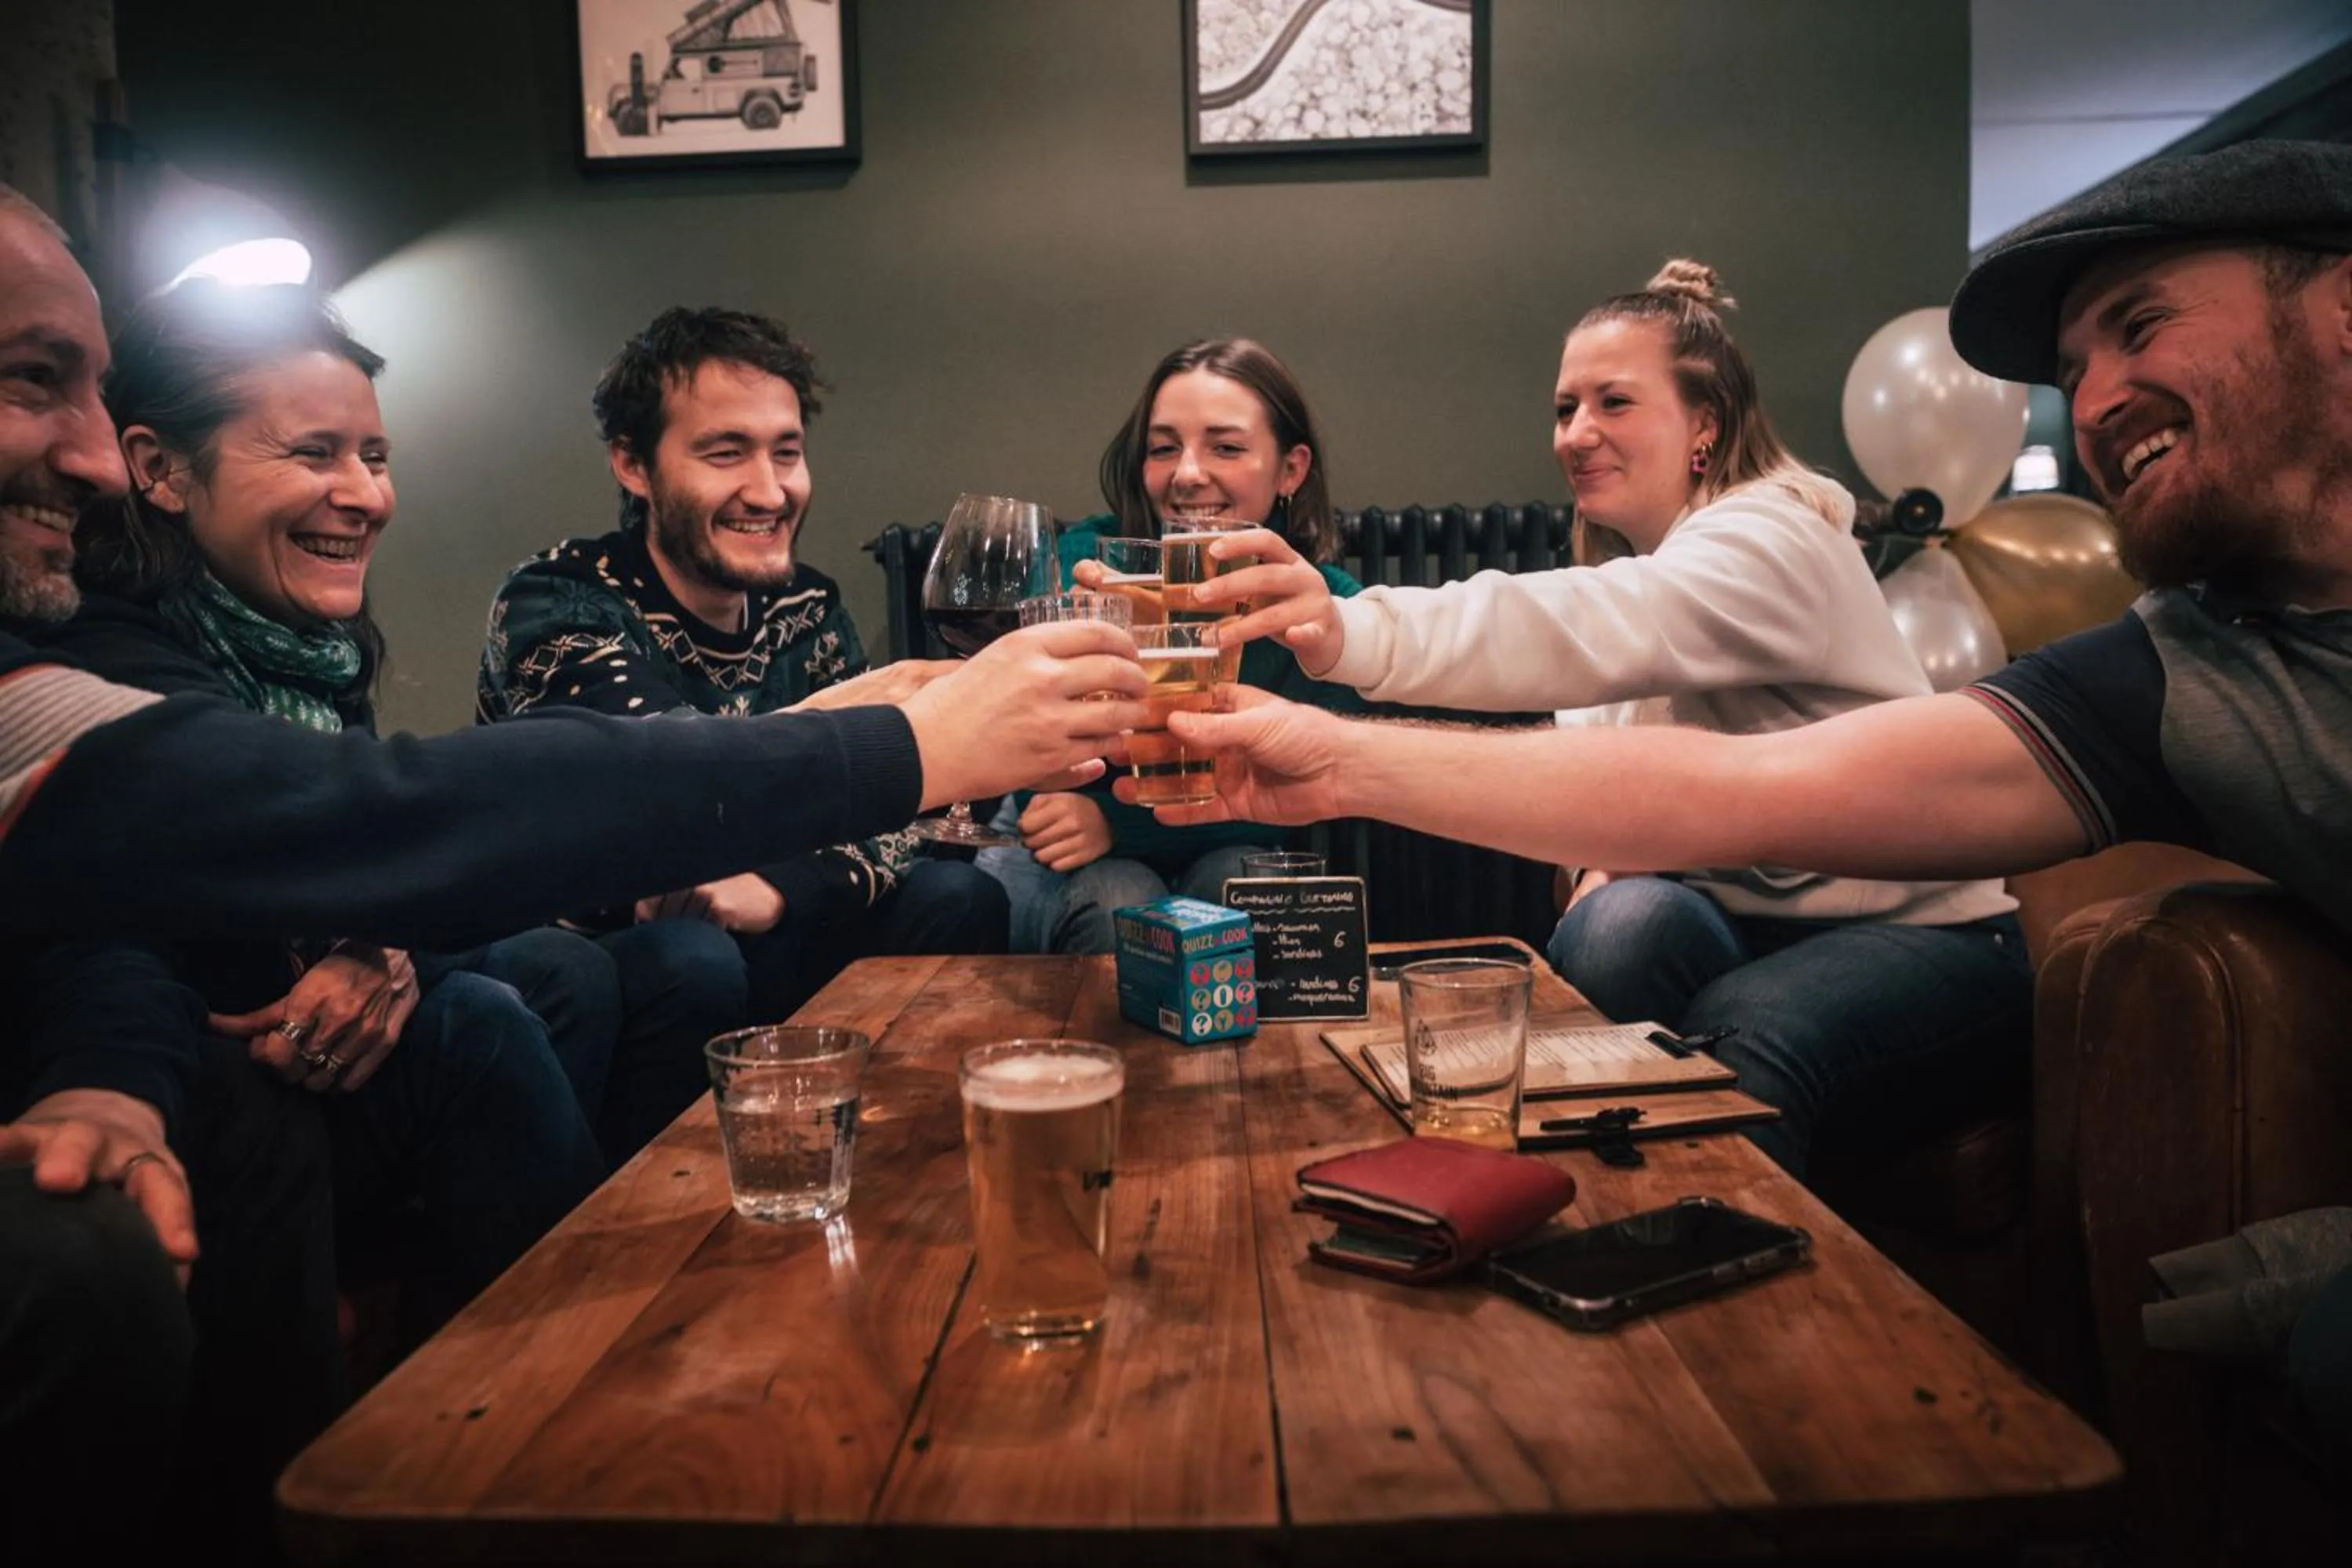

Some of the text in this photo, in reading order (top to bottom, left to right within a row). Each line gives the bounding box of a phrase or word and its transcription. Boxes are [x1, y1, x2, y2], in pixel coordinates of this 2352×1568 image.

[1181, 934, 1214, 954] QUIZZ
[1222, 927, 1248, 944] COOK
[1334, 931, 1347, 948] 6
[1348, 976, 1362, 993] 6
